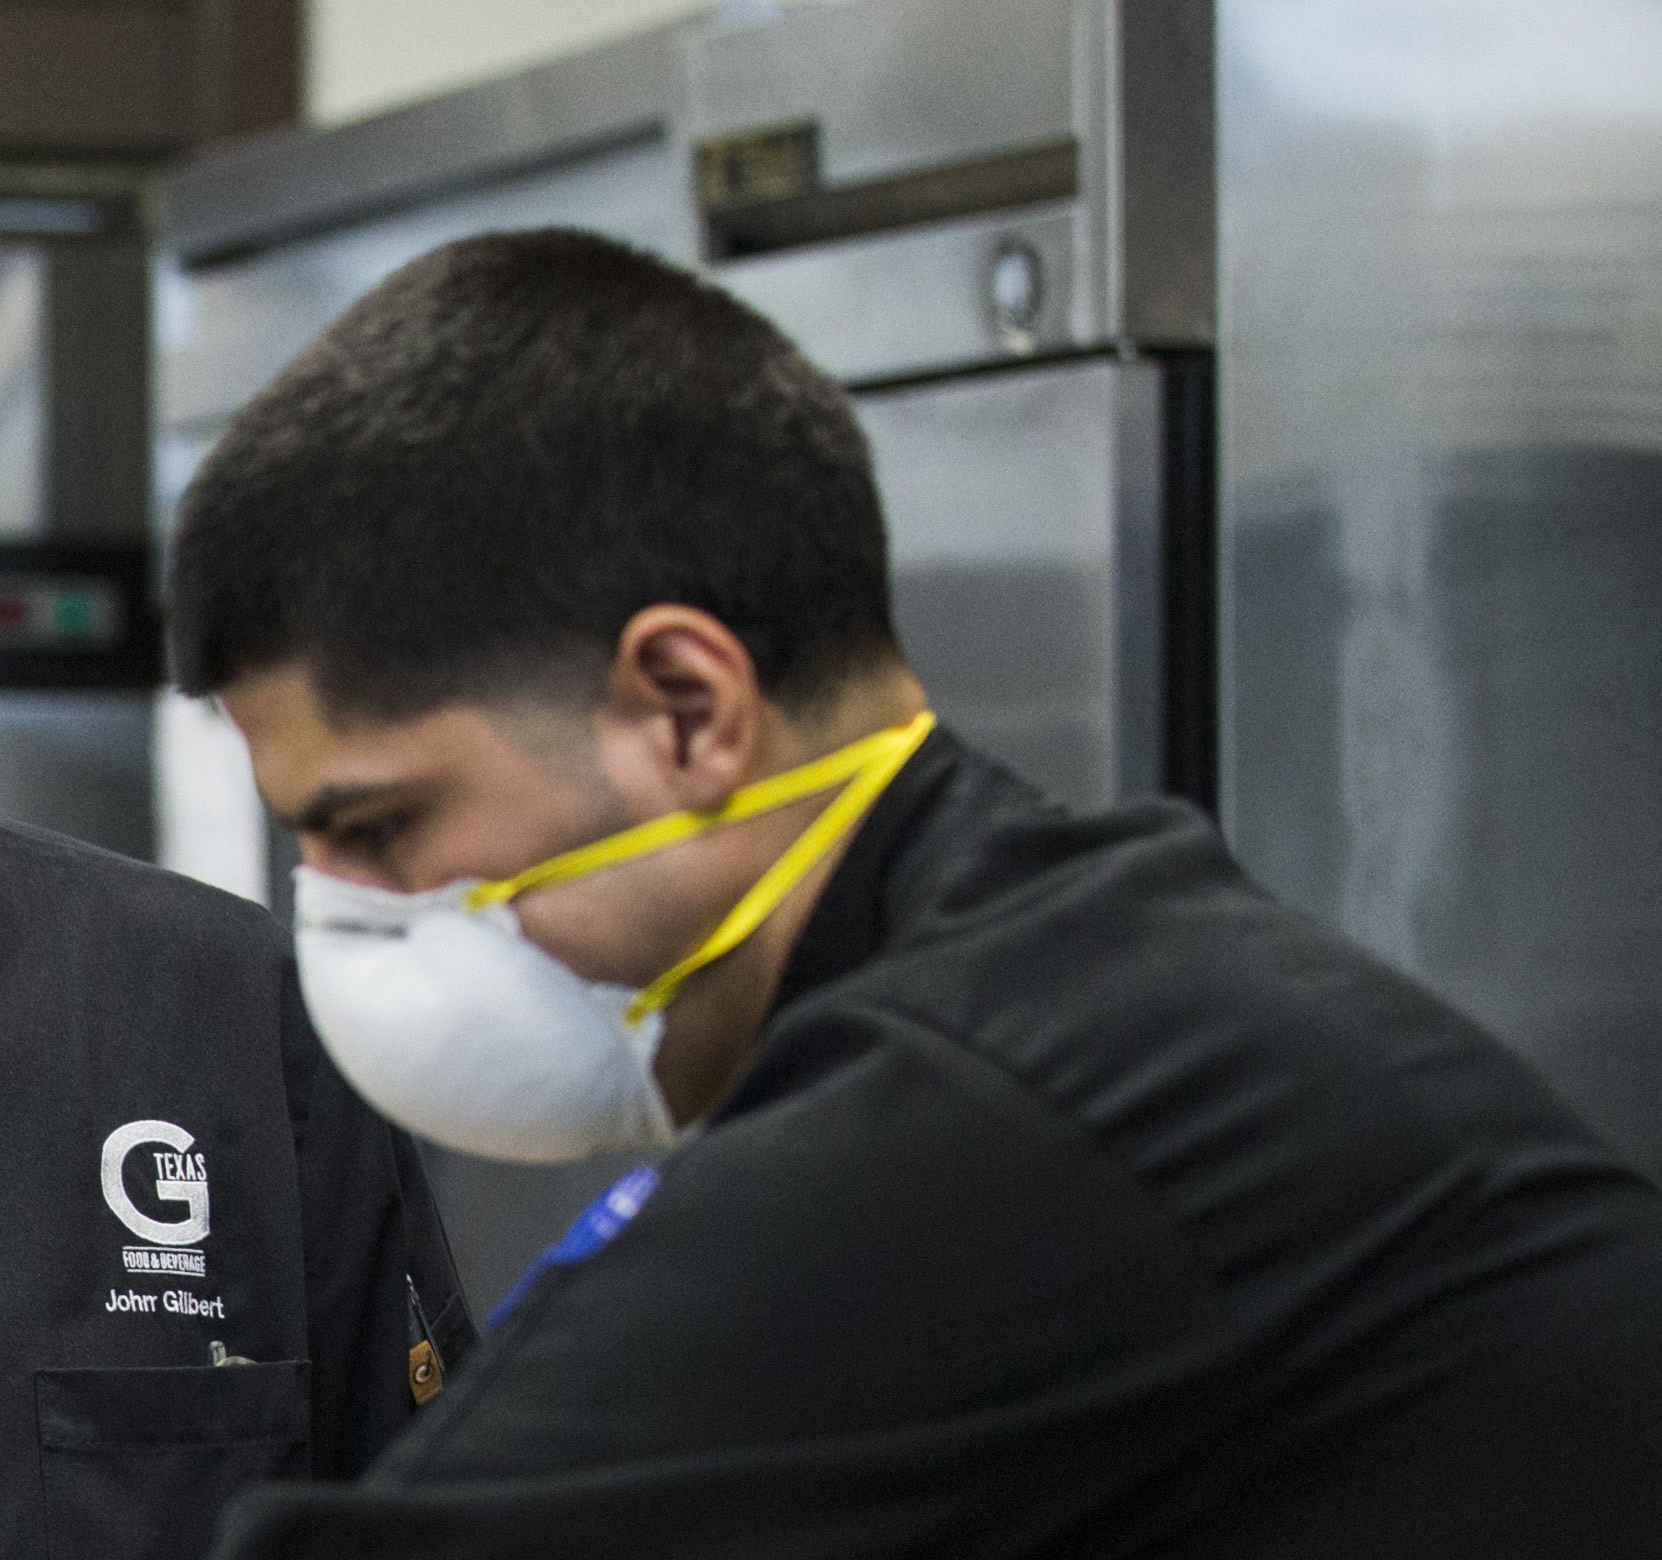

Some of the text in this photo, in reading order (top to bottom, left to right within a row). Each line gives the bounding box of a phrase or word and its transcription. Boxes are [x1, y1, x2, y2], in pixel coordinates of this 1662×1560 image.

[153, 1152, 208, 1181] TEXAS
[100, 1119, 211, 1245] G
[122, 1250, 150, 1269] FOOD
[160, 1252, 206, 1273] BEVERAGE
[162, 1290, 225, 1319] Gilbert
